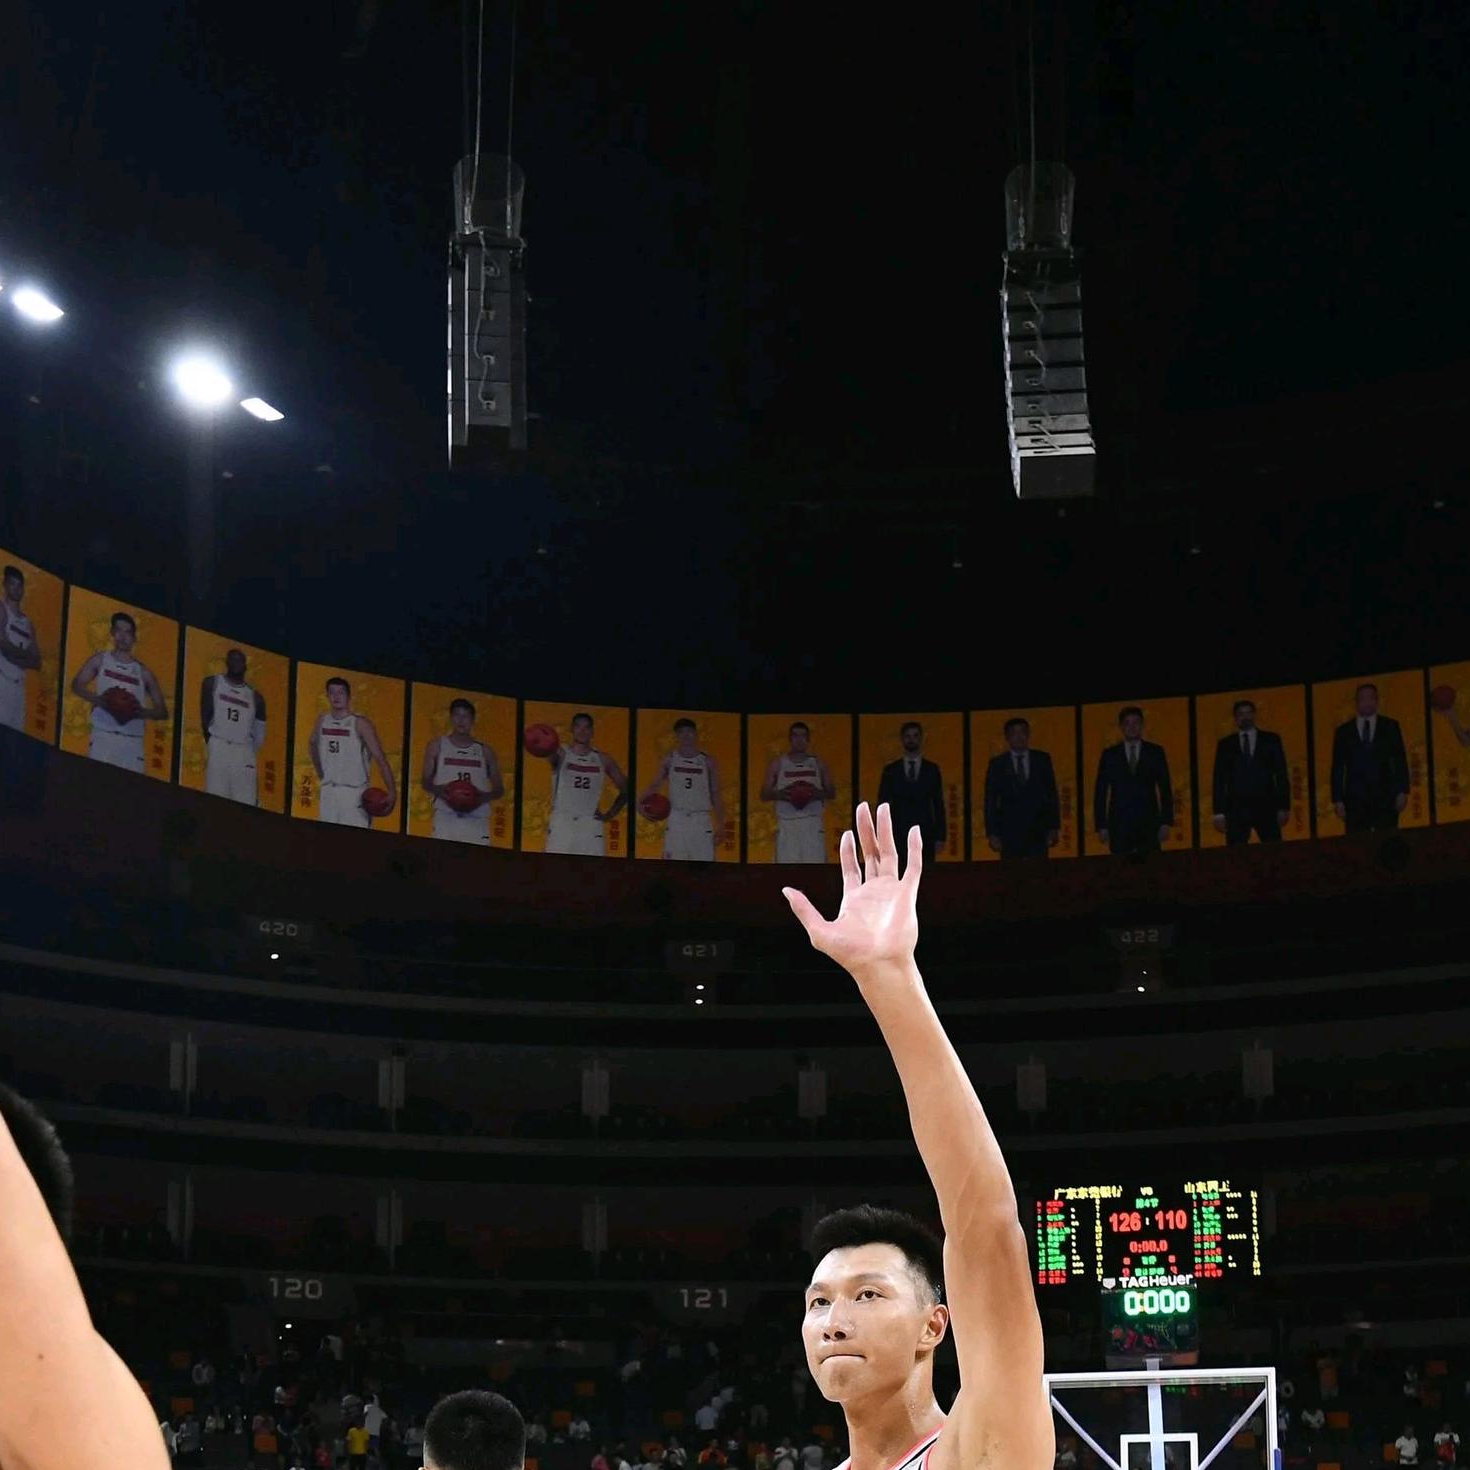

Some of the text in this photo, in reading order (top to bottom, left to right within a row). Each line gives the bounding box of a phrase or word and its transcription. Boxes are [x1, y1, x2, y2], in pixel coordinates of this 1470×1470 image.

[259, 920, 299, 937] 420
[1121, 928, 1160, 943] 422
[682, 944, 718, 957] 421
[1109, 1209, 1187, 1232] 126 110
[270, 1278, 323, 1300] 120
[679, 1288, 728, 1308] 121
